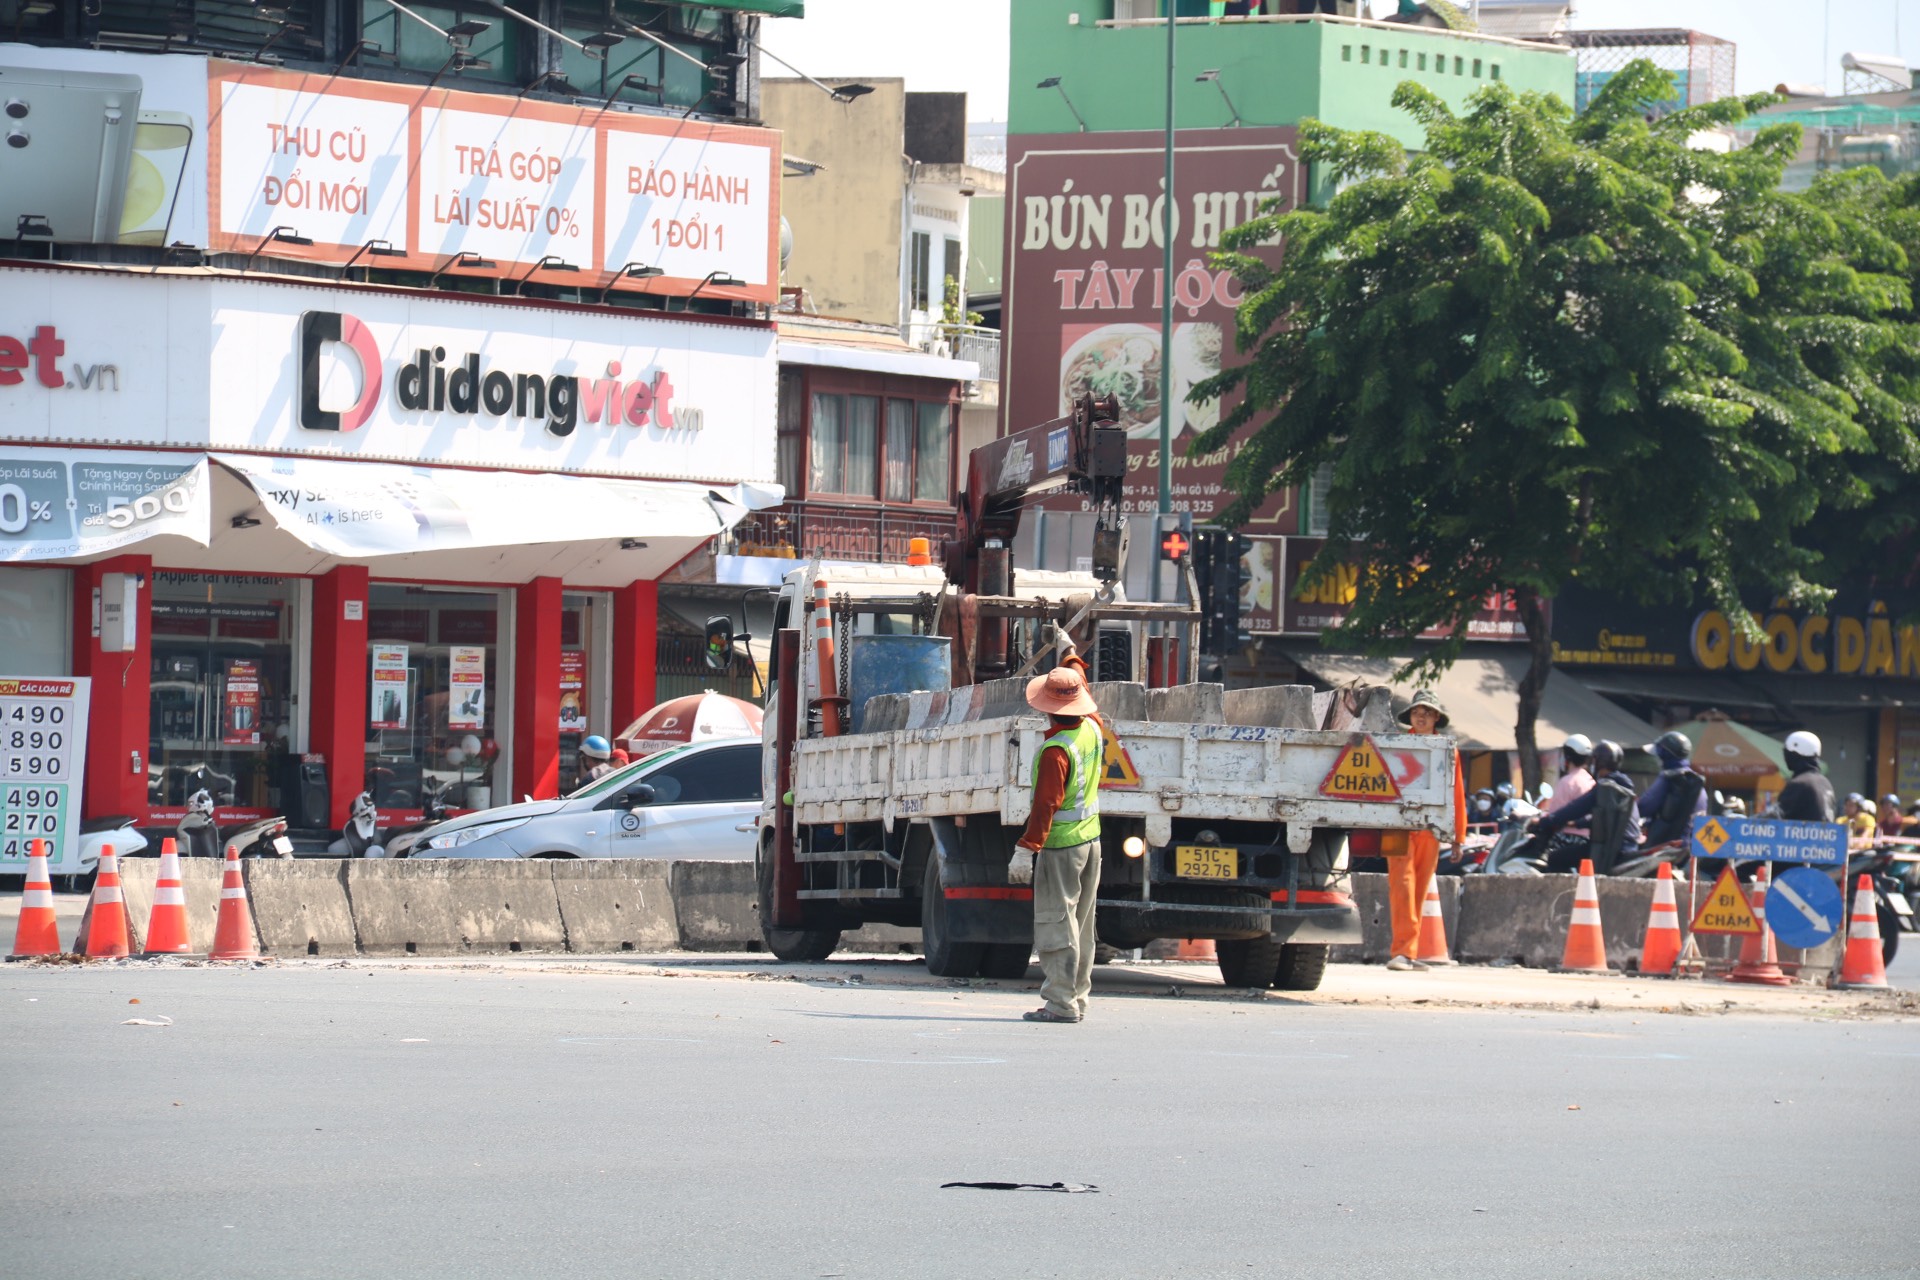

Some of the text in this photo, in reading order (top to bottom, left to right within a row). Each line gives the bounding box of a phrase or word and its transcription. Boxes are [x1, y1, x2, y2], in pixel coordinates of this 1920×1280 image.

[266, 123, 366, 163] THU CŨ
[455, 141, 561, 184] TRẢ GÓP
[263, 167, 368, 215] ĐỔI MỚI
[627, 162, 749, 205] BẢO HÀNH
[434, 192, 580, 239] LÃI SUẤT 0%
[1022, 178, 1112, 250] BÚN
[652, 211, 724, 252] 1 ĐỔI 1
[1053, 260, 1144, 310] TÂY
[395, 344, 705, 438] didongviet.vn
[14, 466, 30, 479] Lãi
[32, 466, 57, 479] Suất
[83, 468, 111, 482] Tặng
[114, 470, 142, 482] Ngay
[146, 466, 162, 483] Ốp
[79, 480, 111, 492] Chính
[114, 481, 142, 493] Hãng
[1189, 483, 1202, 496] GÒ
[1204, 483, 1222, 496] VẤP
[1193, 500, 1214, 512] 325
[83, 513, 104, 526] Giá
[352, 508, 383, 521] here
[1255, 618, 1272, 630] 325
[20, 682, 37, 693] CÁC
[38, 684, 58, 695] LOẠI
[1351, 752, 1370, 768] ĐI
[1334, 772, 1387, 794] CHẬM
[1194, 848, 1220, 863] 51C
[1776, 845, 1798, 858] THI
[1801, 844, 1836, 860] CÔNG
[1184, 862, 1231, 877] 292.76
[1719, 893, 1735, 907] ĐI
